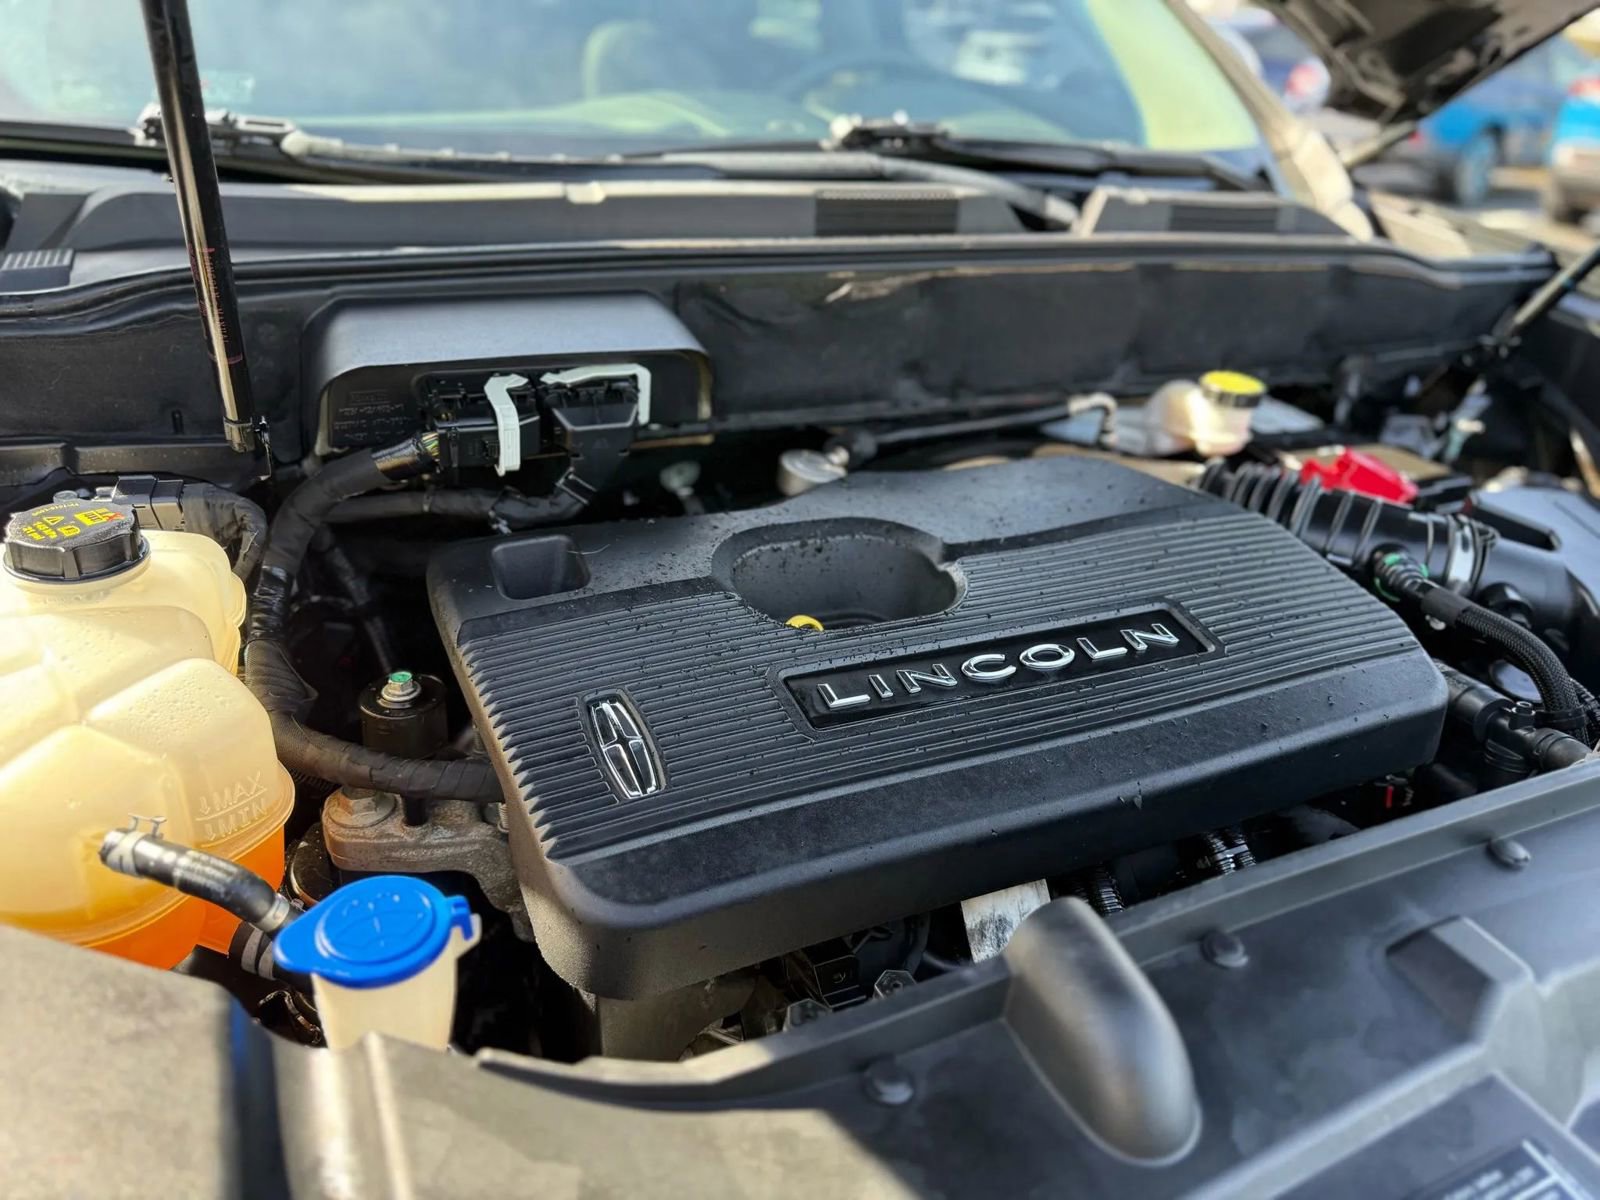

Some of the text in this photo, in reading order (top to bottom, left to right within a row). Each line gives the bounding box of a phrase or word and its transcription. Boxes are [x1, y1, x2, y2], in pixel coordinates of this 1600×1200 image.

[817, 623, 1179, 710] LINCOLN
[213, 770, 267, 811] MAX
[219, 797, 268, 837] MIN
